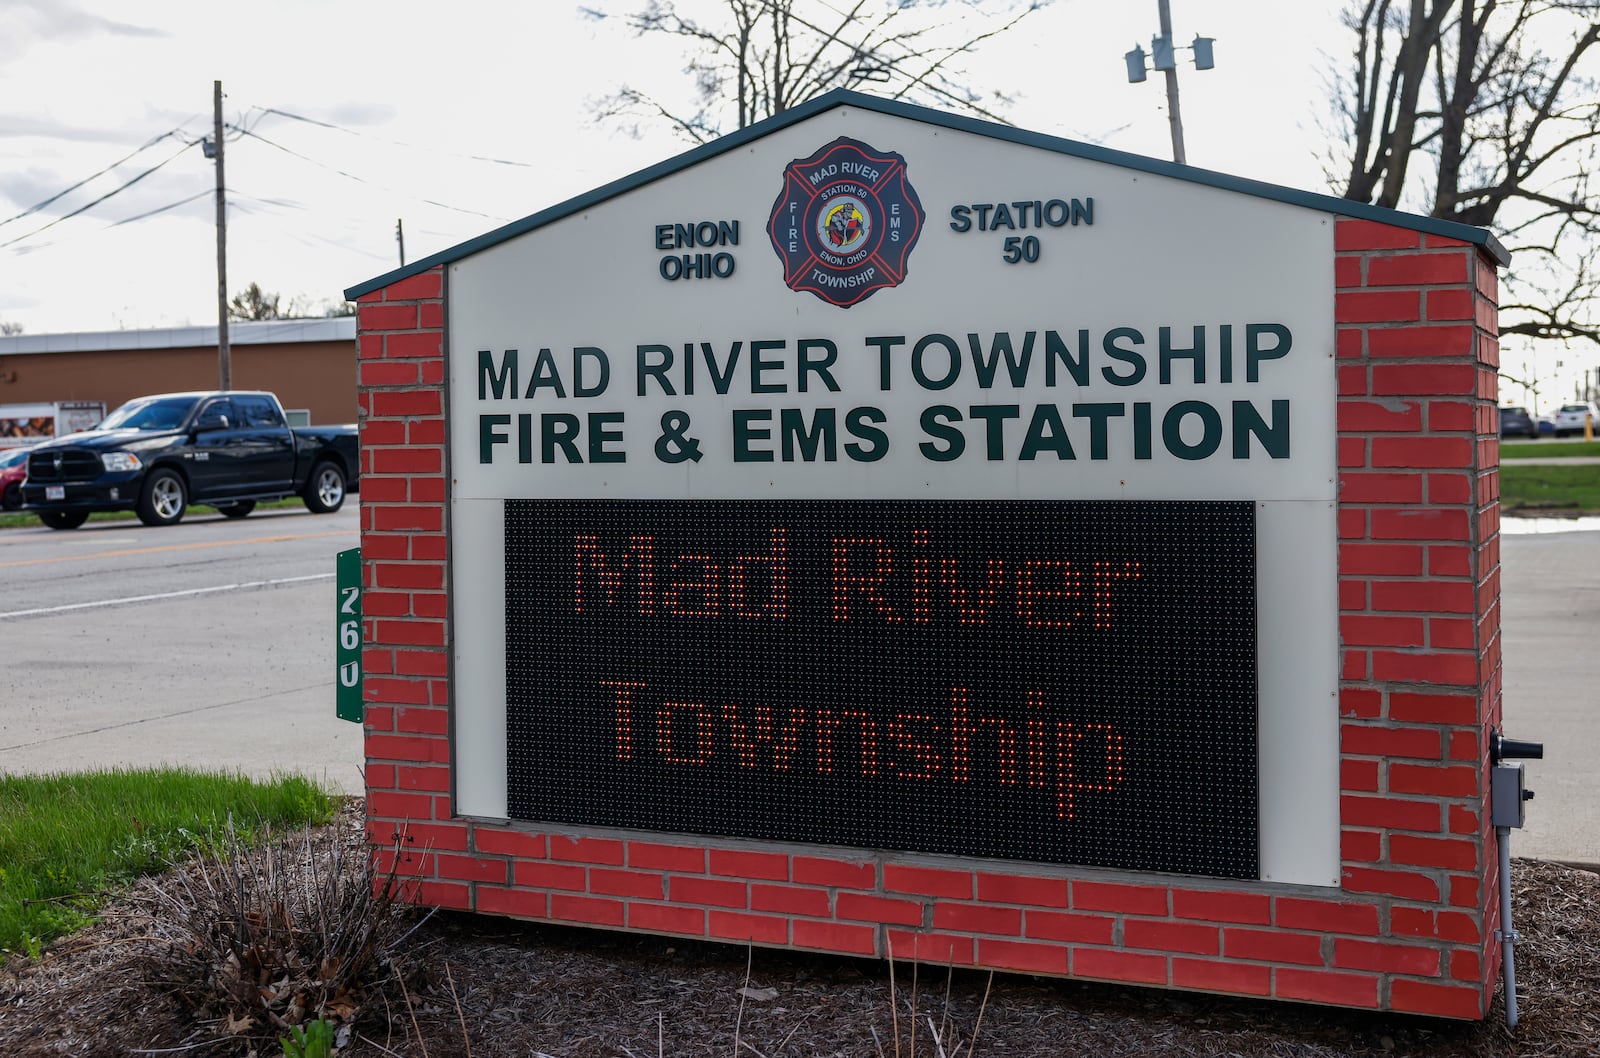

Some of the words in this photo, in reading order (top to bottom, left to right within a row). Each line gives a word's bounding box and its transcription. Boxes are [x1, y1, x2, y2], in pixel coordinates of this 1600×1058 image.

[809, 163, 838, 186] MAD
[841, 162, 880, 183] RIVER
[821, 184, 856, 201] STATION
[857, 188, 867, 199] 50
[789, 203, 797, 252] FIRE
[890, 204, 900, 241] EMS
[949, 197, 1094, 233] STATION
[654, 219, 739, 250] ENON
[1002, 236, 1040, 264] 50
[659, 252, 735, 281] OHIO
[819, 250, 845, 266] ENON,
[847, 249, 867, 265] OHIO
[811, 267, 875, 288] TOWNSHIP
[478, 346, 611, 400] MAD
[636, 338, 842, 397] RIVER
[865, 323, 1293, 391] TOWNSHIP
[479, 411, 627, 464] FIRE
[654, 410, 704, 464] &
[732, 406, 890, 463] EMS
[918, 399, 1291, 462] STATION
[576, 527, 788, 619] Mad
[832, 529, 1141, 628] River
[601, 680, 1123, 818] Township
